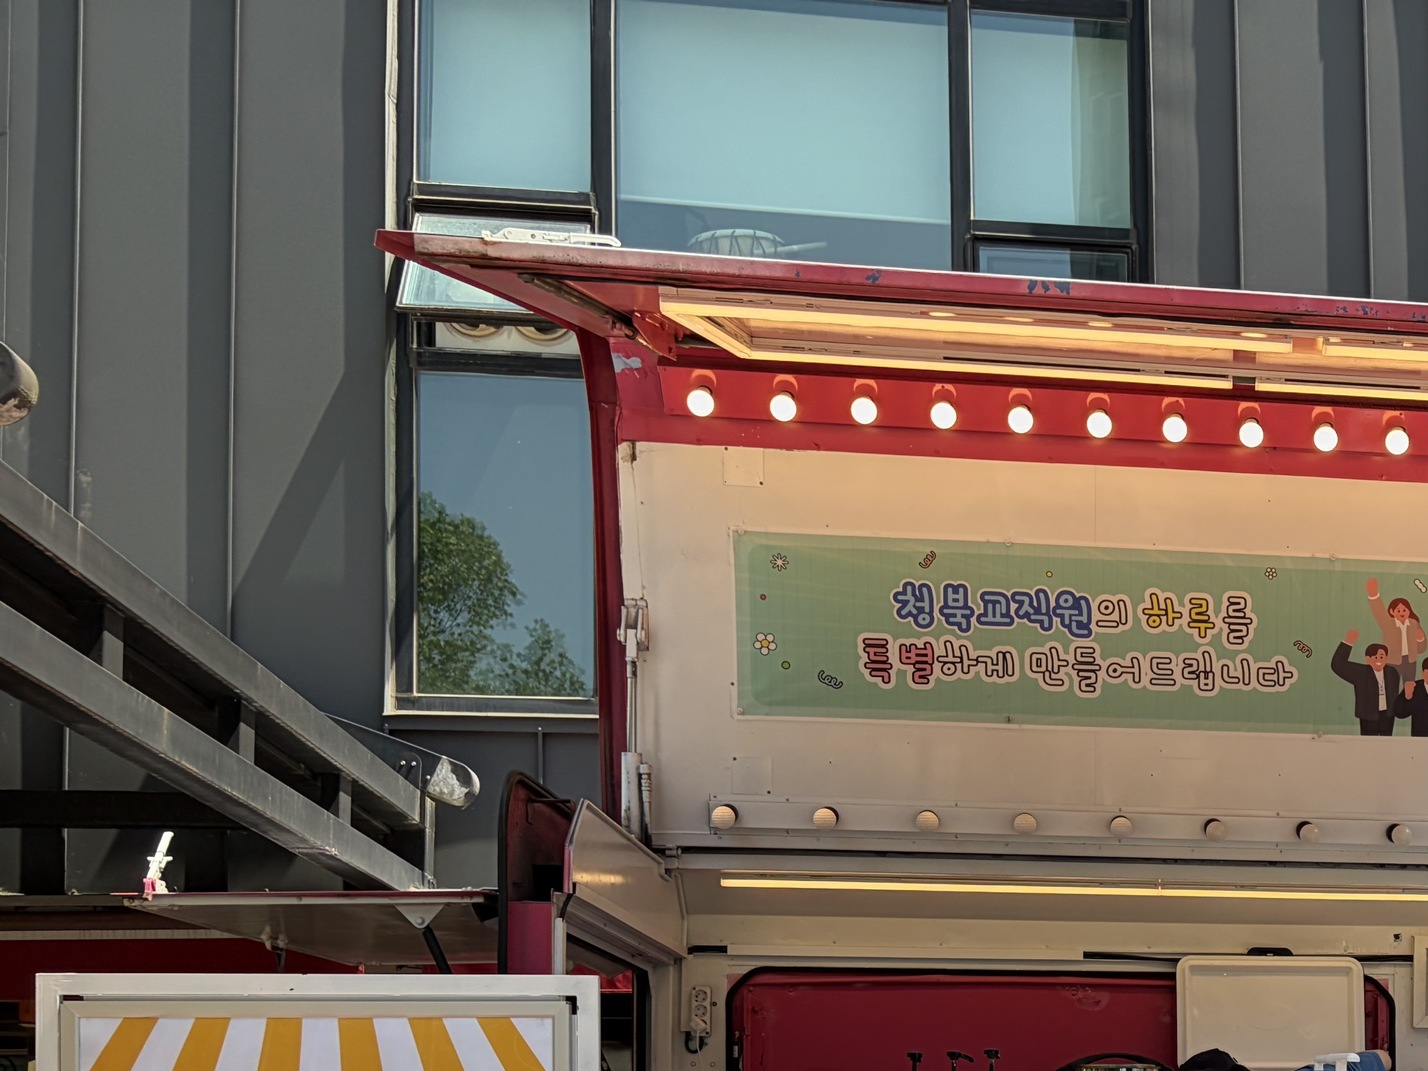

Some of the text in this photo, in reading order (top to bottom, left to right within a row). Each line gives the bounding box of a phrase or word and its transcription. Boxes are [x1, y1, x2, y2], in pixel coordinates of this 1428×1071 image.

[893, 580, 1253, 646] 청북교직원의 하루를
[862, 637, 1294, 693] 특별하게 만들어드립니다
